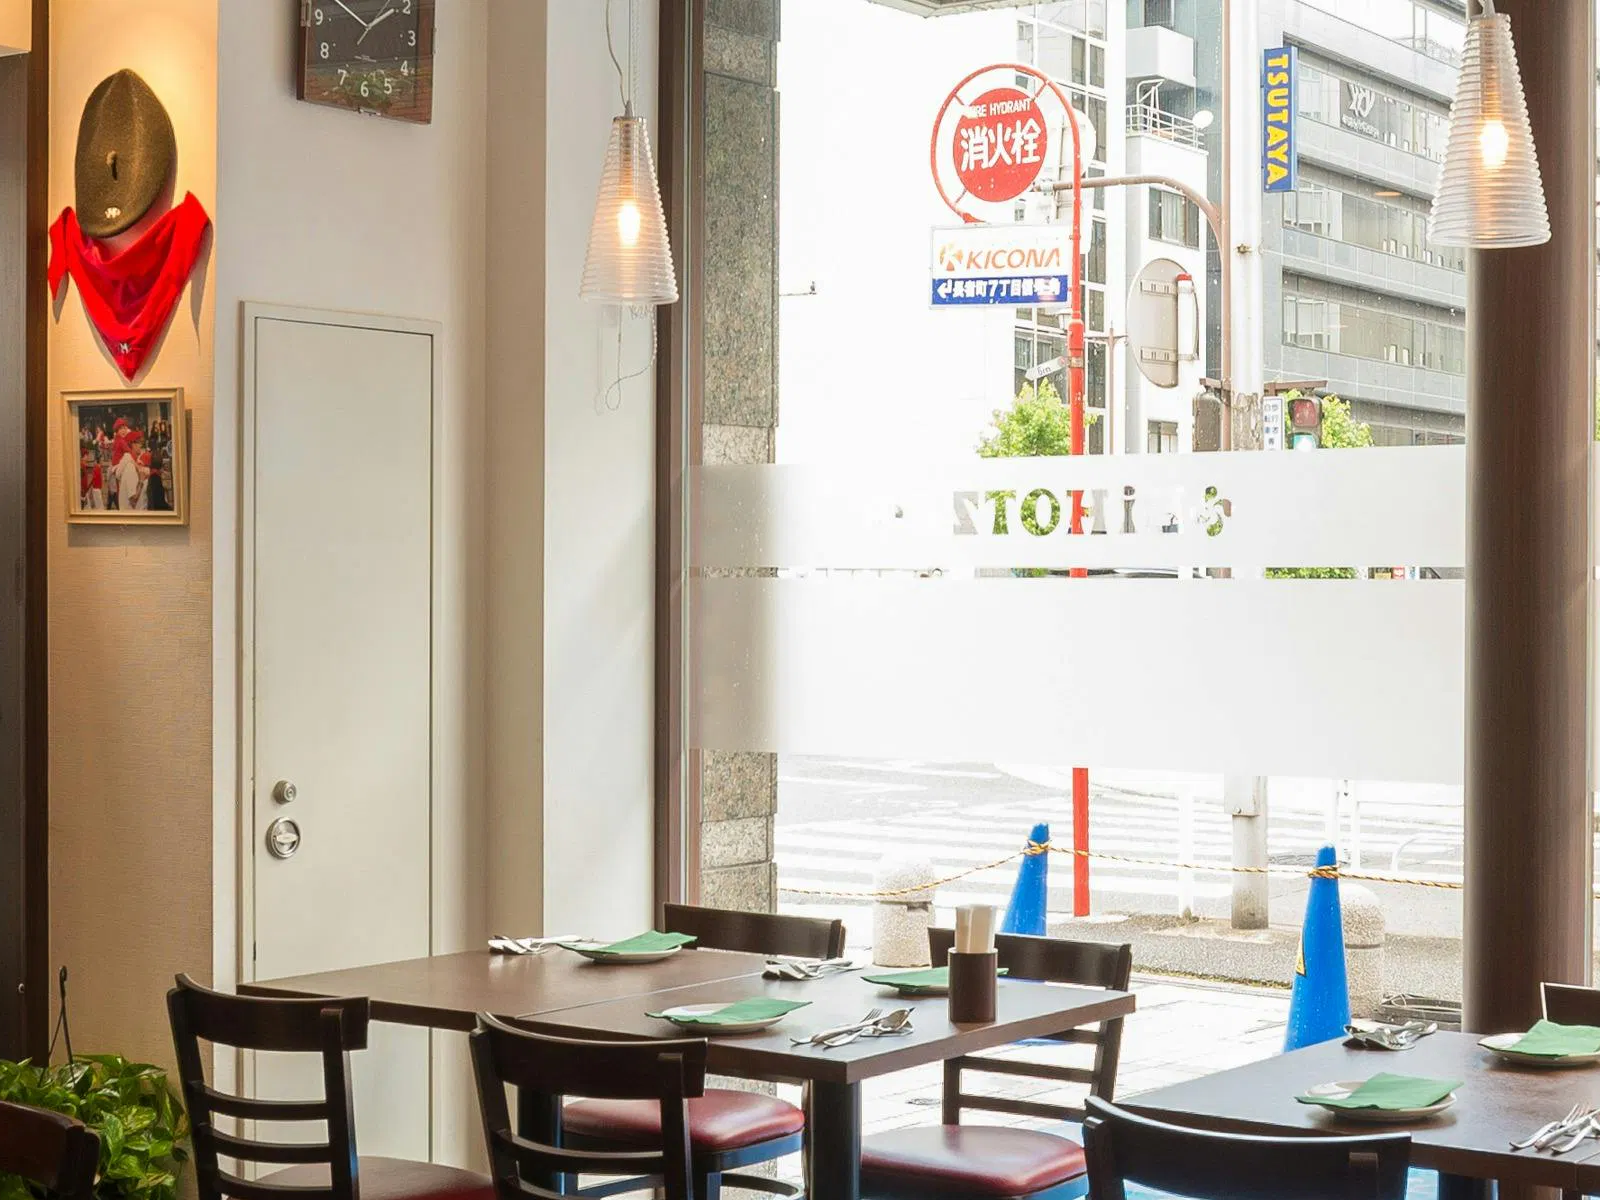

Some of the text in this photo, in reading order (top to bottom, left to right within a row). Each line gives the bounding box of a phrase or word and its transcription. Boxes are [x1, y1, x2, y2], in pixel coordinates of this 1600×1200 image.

[315, 9, 323, 25] 9
[408, 30, 416, 46] 3
[320, 42, 329, 59] 8
[400, 60, 409, 76] 4
[337, 69, 348, 85] 7
[360, 81, 369, 97] 6
[384, 78, 392, 94] 5
[990, 99, 1031, 116] HYDRANT
[1267, 54, 1289, 185] TSUTAYA
[960, 118, 1041, 172] 消火栓
[966, 247, 1060, 270] KICONA
